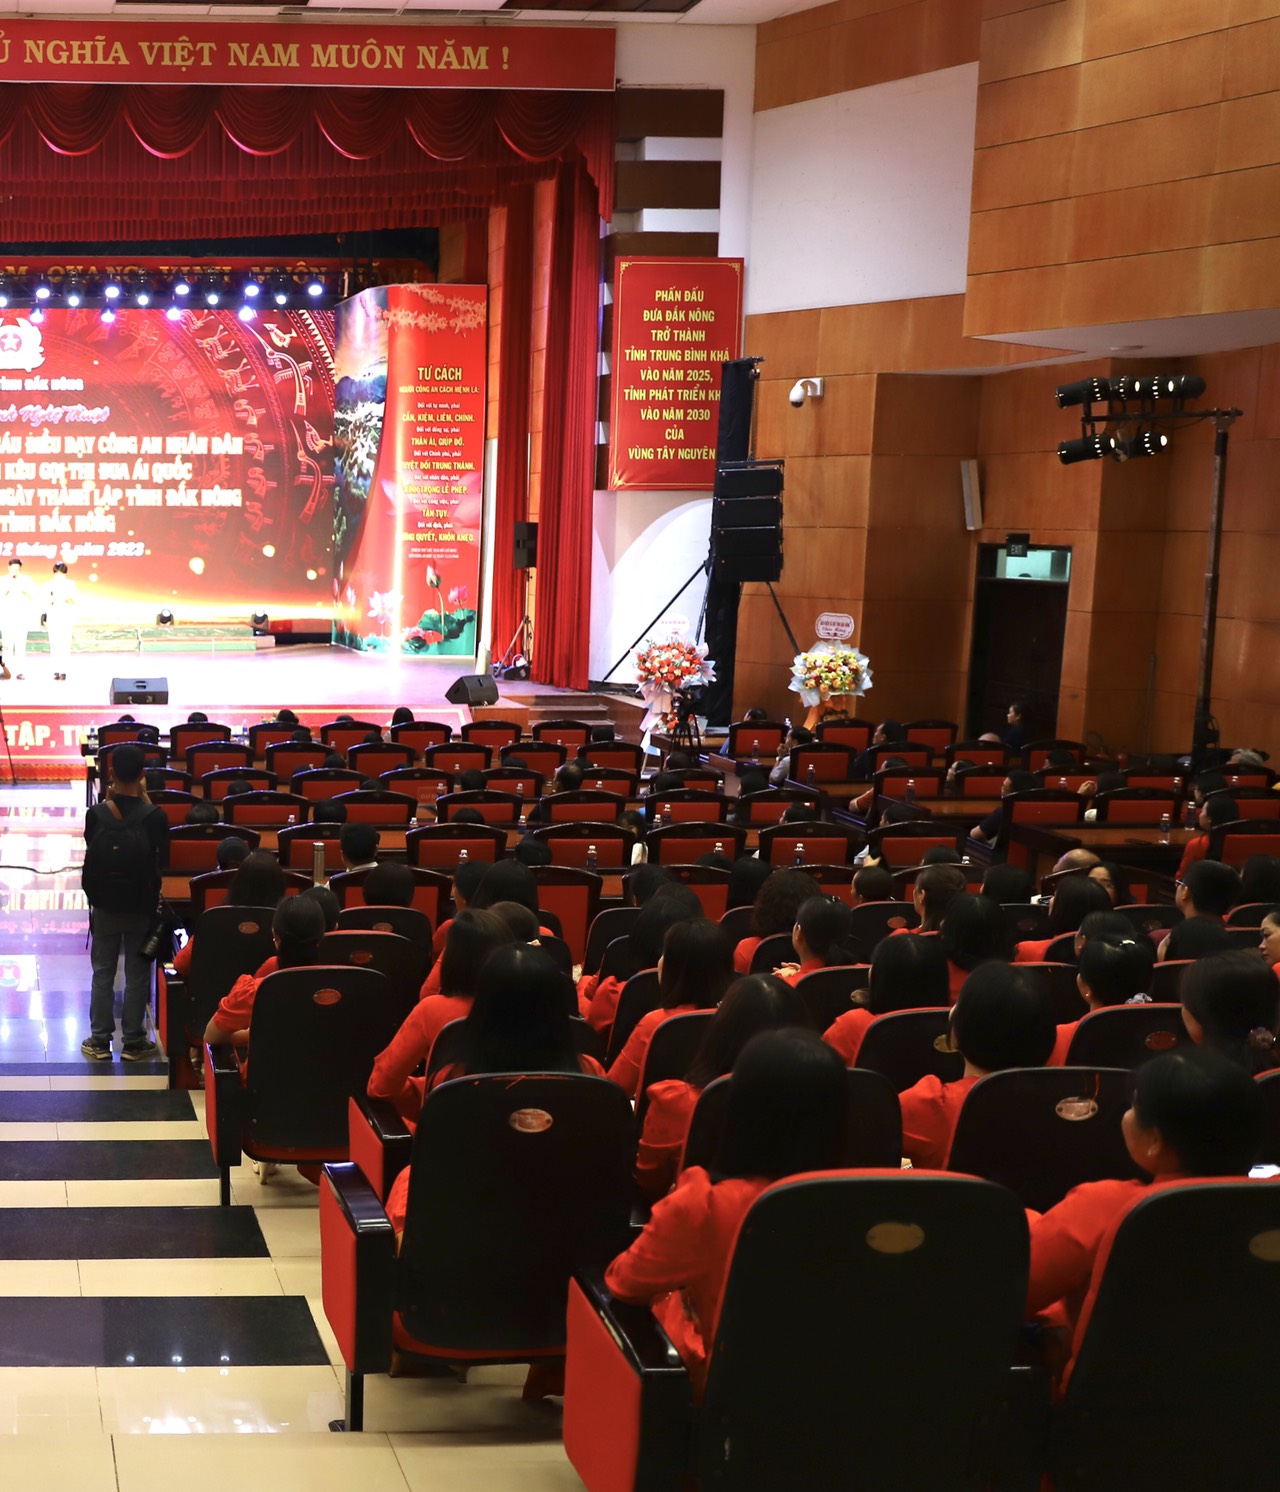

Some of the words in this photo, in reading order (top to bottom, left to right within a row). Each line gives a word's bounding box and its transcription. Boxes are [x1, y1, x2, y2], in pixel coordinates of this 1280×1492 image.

[23, 33, 130, 66] NGHĨA
[138, 35, 217, 73] VIỆT
[227, 42, 300, 69] NAM
[310, 38, 406, 69] MUÔN
[416, 37, 490, 71] NĂM
[500, 45, 512, 71] !
[655, 286, 682, 302] PHẤN
[684, 286, 704, 302] ĐẤU
[642, 308, 663, 322] ĐƯA
[665, 305, 686, 322] ĐẮK
[688, 307, 715, 322] NÔNG
[650, 326, 672, 342] TRỞ
[673, 327, 706, 342] THÀNH
[624, 345, 647, 361] TỈNH
[650, 349, 682, 362] TRUNG
[684, 346, 707, 361] BÌNH
[710, 346, 730, 362] KHÁ
[417, 364, 433, 381] TƯ
[434, 364, 462, 381] CÁCH
[640, 366, 660, 381] VÀO
[662, 367, 684, 381] NĂM
[686, 369, 713, 383] 2025,
[51, 376, 84, 391] NÔNG
[623, 385, 646, 401] TỈNH
[649, 386, 674, 401] PHÁT
[676, 384, 706, 401] TRIỂN
[708, 389, 721, 401] KH
[640, 405, 660, 421] VÀO
[662, 406, 684, 421] NĂM
[686, 409, 711, 421] 2030
[665, 424, 684, 440] CỦA
[64, 436, 96, 459] DẠY
[98, 431, 138, 454] CÔNG
[140, 436, 163, 454] AN
[165, 431, 208, 455] NHÂN
[211, 431, 244, 455] DÂN
[628, 444, 654, 460] VÙNG
[656, 445, 675, 460] TÂY
[677, 445, 716, 460] NGUYÊN
[4, 458, 36, 480] KÊU
[39, 462, 66, 485] GỌI
[68, 462, 95, 480] THI
[98, 462, 130, 480] ĐUA
[132, 457, 149, 480] ÁI
[152, 454, 193, 483] QUỐC
[37, 484, 90, 506] THÀNH
[93, 484, 124, 511] LẬP
[125, 483, 163, 506] TỈNH
[201, 484, 242, 507] NÔNG
[0, 510, 36, 533] TỈNH
[75, 510, 116, 533] NÔNG
[1011, 544, 1023, 554] EXIT
[4, 720, 56, 751] TẬP,
